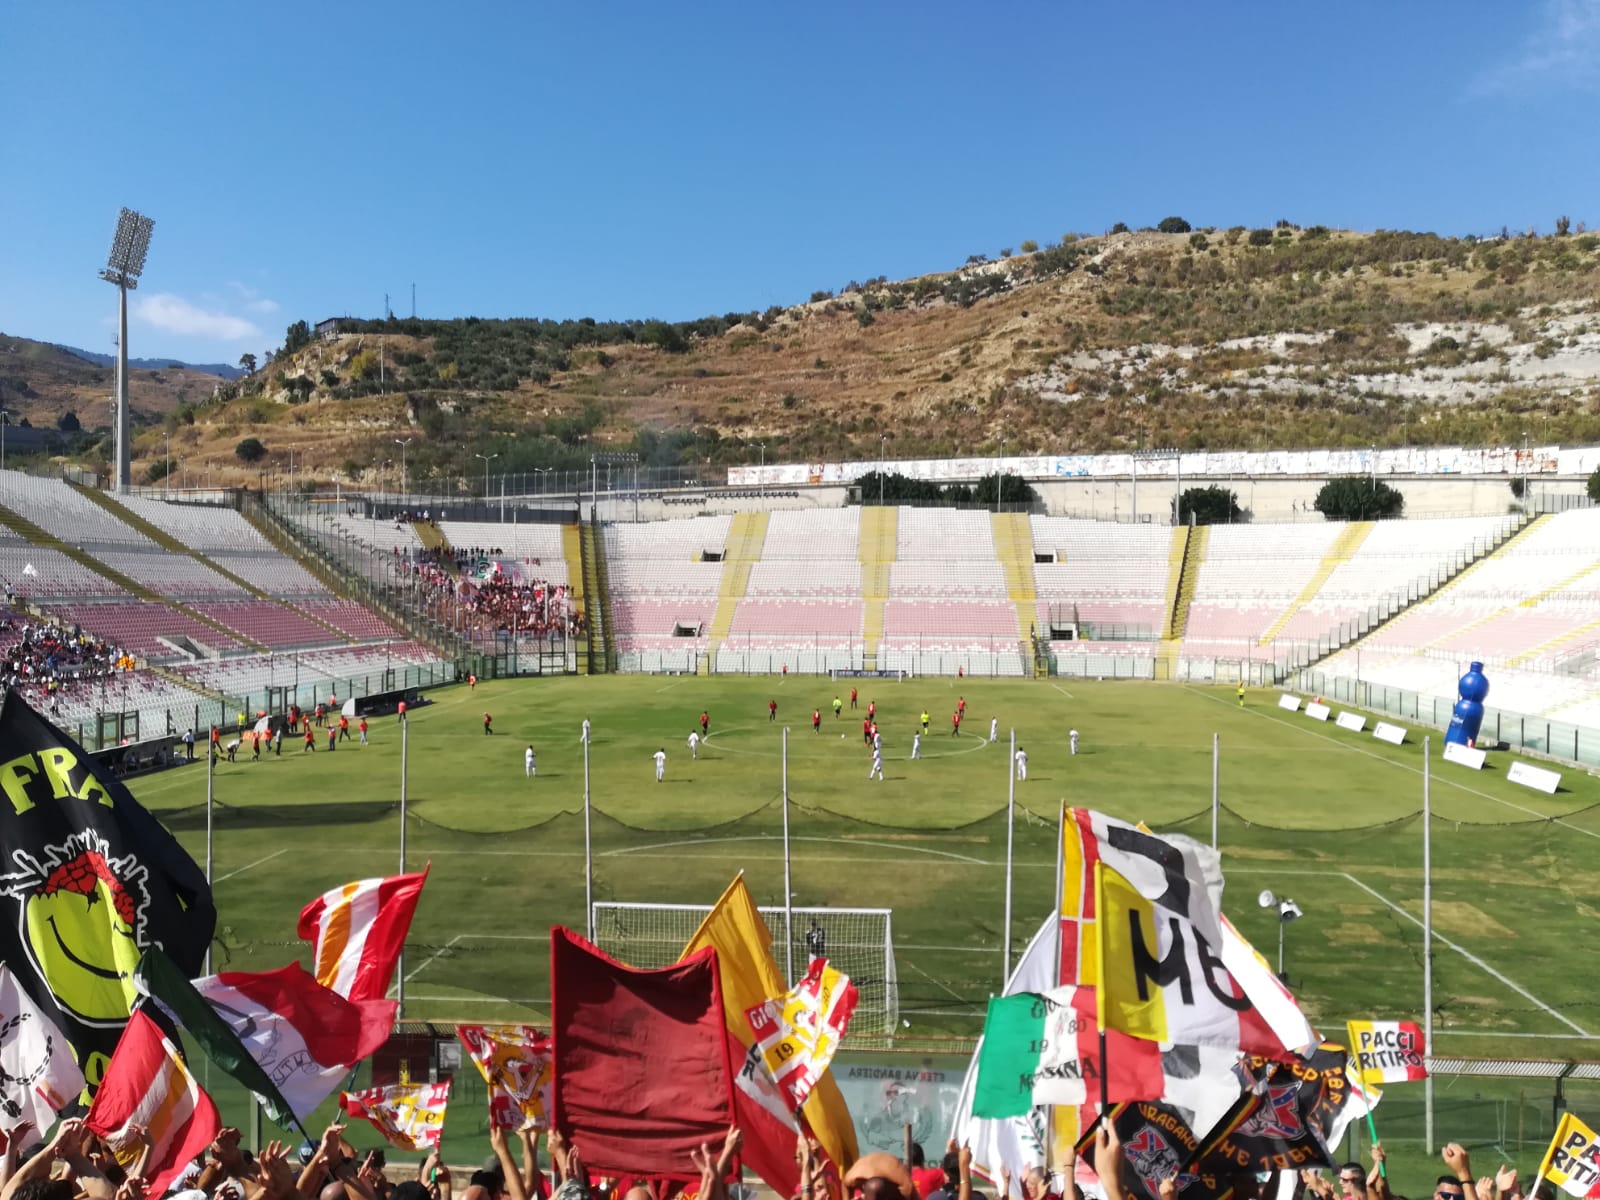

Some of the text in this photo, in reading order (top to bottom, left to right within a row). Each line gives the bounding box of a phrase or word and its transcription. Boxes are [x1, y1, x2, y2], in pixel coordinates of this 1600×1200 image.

[1068, 1019, 1087, 1035] 80
[1028, 1039, 1048, 1053] 19
[1360, 1030, 1414, 1050] PACCI
[775, 1042, 794, 1061] 19
[1358, 1050, 1421, 1069] RITIRO
[1549, 1147, 1599, 1186] RITI
